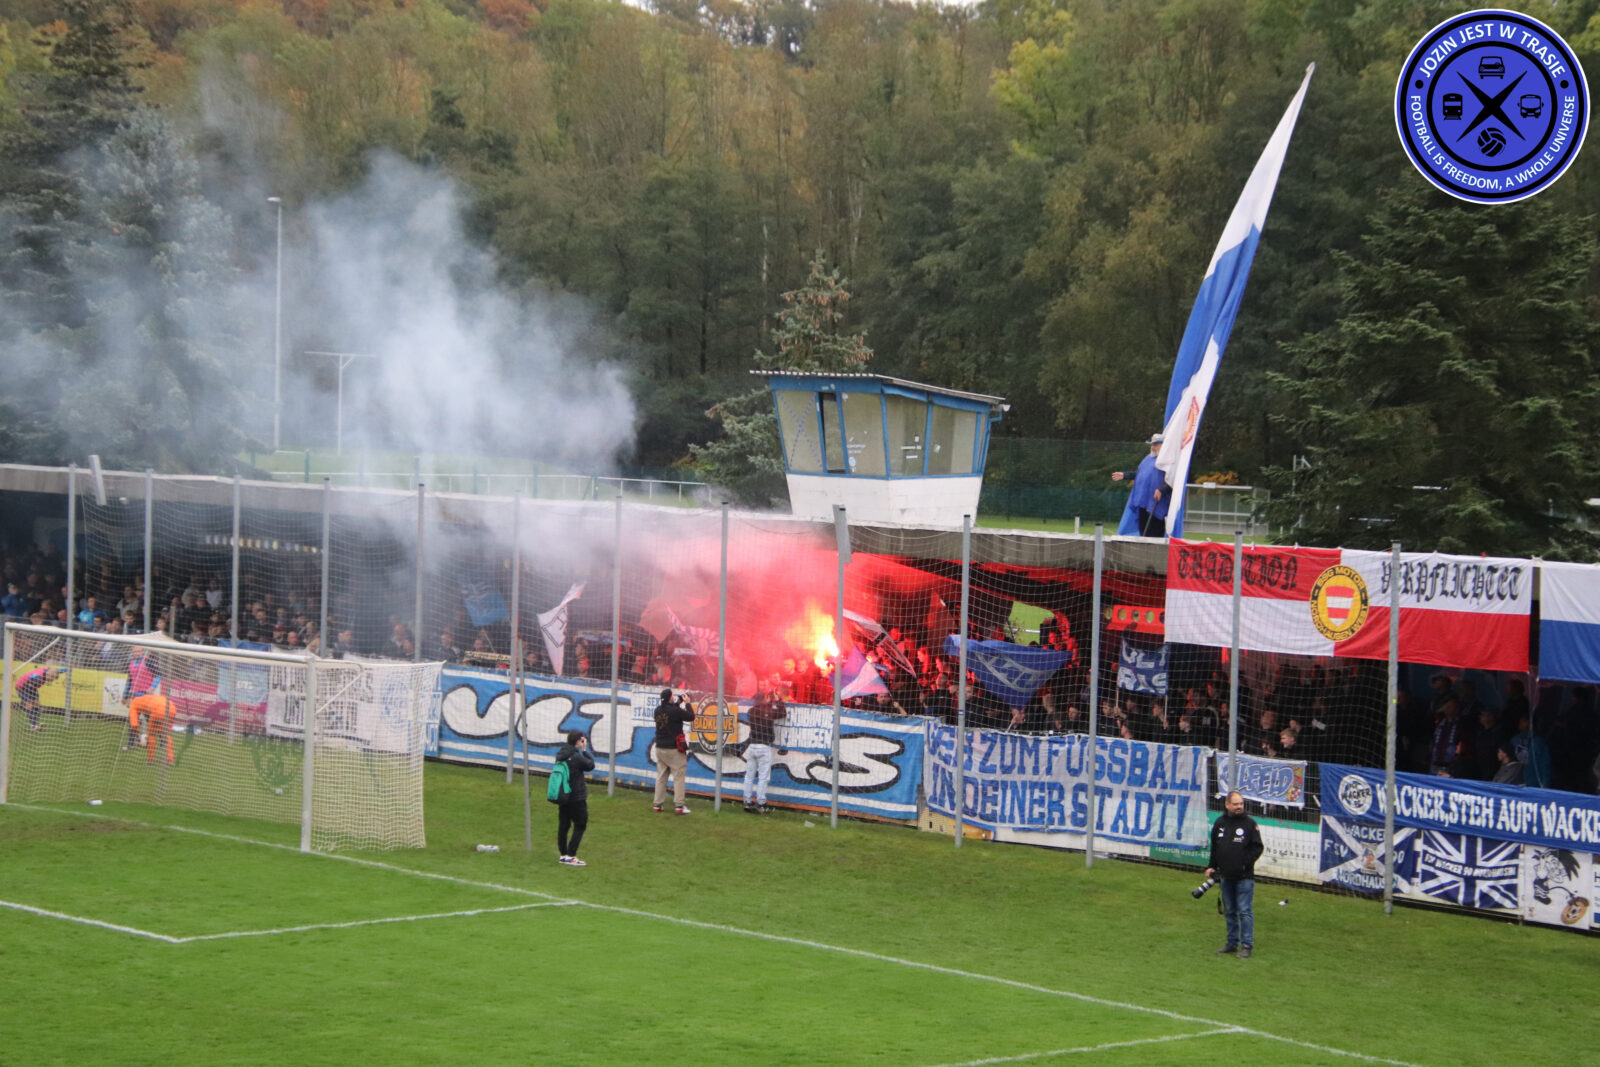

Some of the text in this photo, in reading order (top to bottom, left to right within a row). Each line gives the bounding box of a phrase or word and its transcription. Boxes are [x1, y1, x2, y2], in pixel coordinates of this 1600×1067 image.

[1178, 548, 1298, 590] TRADTION
[1335, 566, 1366, 591] MOTOR
[1381, 561, 1522, 604] VRPFLICHTET
[441, 684, 906, 794] ULTS
[693, 716, 734, 732] BADKUVE
[928, 762, 1191, 841] IN DEINER STADT!
[1496, 798, 1538, 836] AUF!
[1342, 822, 1386, 841] WACKE
[1336, 868, 1400, 890] NORDHAUSN
